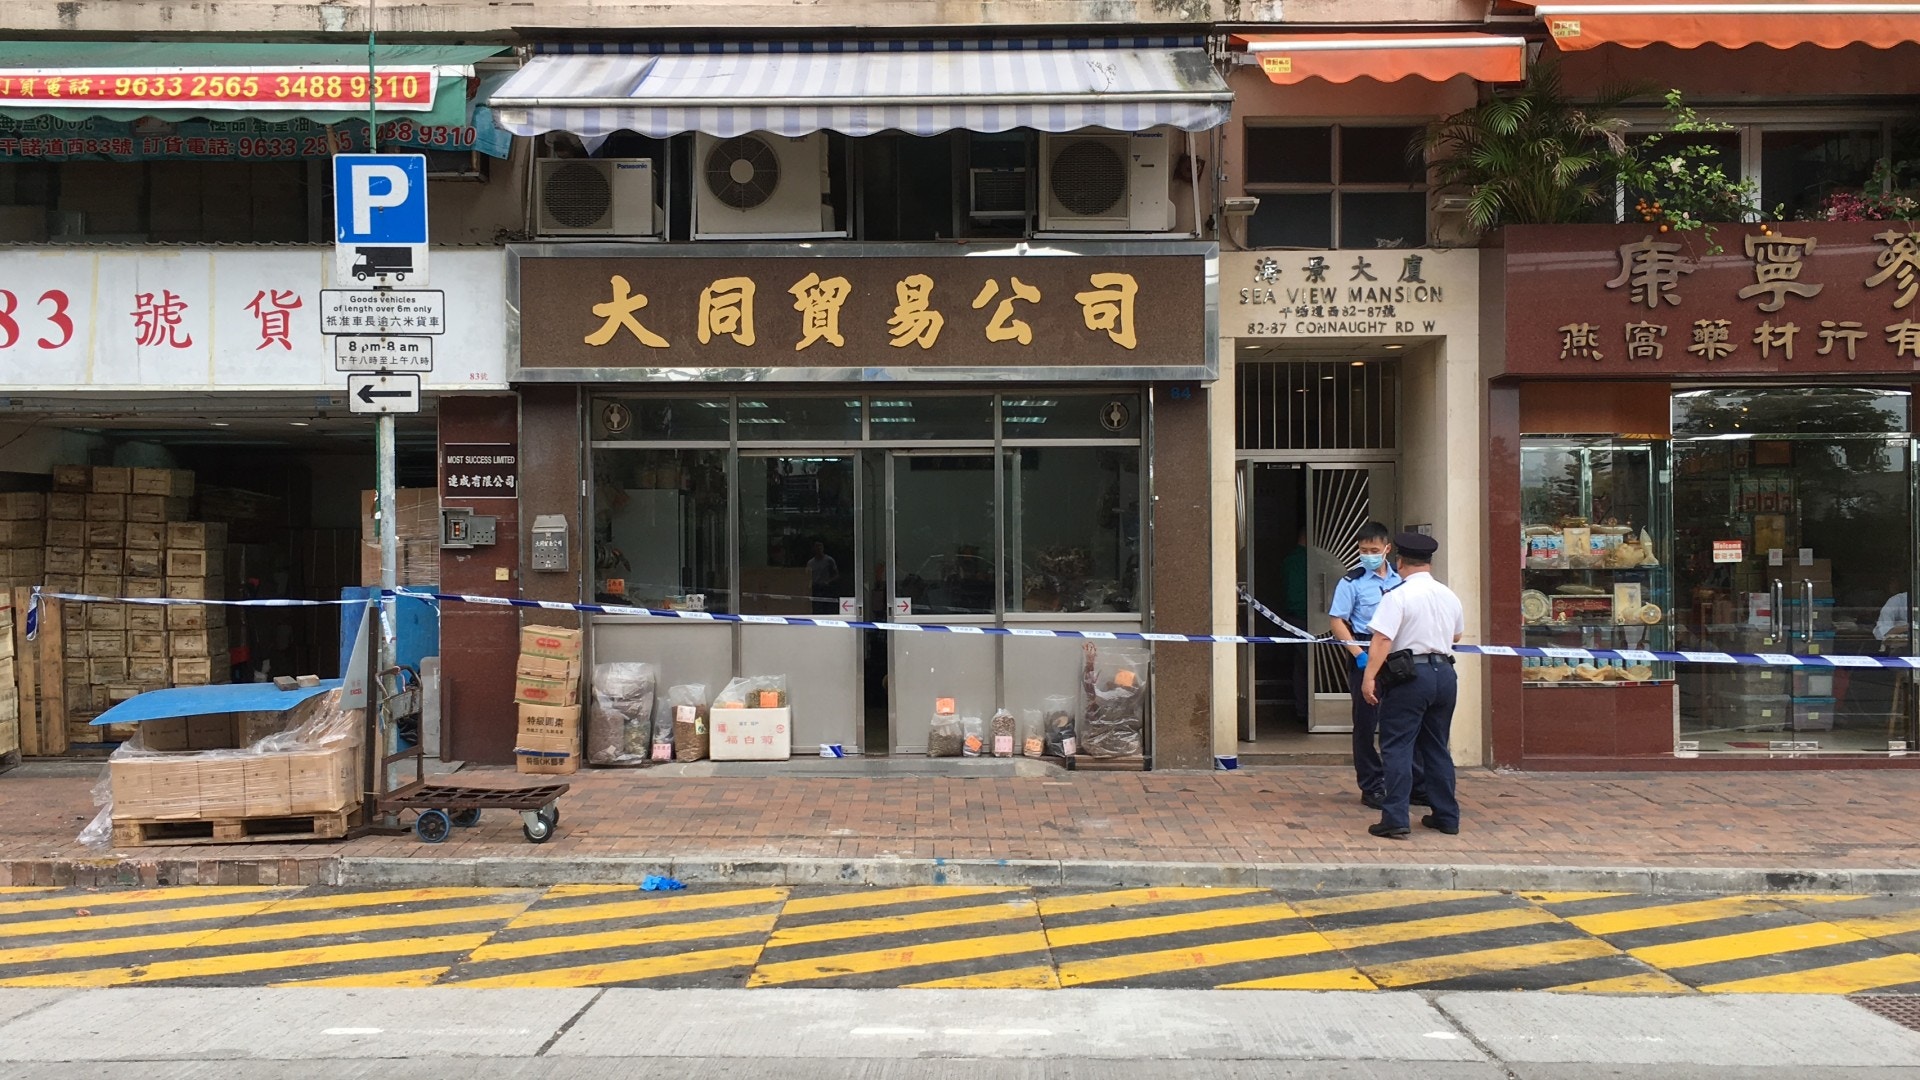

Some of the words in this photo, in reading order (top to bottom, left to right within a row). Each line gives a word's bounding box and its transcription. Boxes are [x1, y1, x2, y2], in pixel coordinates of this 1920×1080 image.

[115, 77, 182, 96] 9633
[191, 76, 259, 97] 2565
[275, 76, 342, 98] 3488
[350, 75, 418, 98] 9310
[0, 137, 133, 156] 干諾道西83號
[143, 136, 235, 155] 訂貨電話:
[239, 136, 297, 157] 9633
[302, 130, 353, 156] 255
[418, 125, 477, 146] 9310
[352, 164, 409, 235] P
[1254, 254, 1426, 285] 海景大廈
[350, 295, 378, 304] Goods
[380, 296, 416, 304] vehicles
[1240, 286, 1279, 305] SEA
[1287, 286, 1337, 304] VIEW
[1349, 285, 1443, 303] MANSION
[333, 305, 342, 313] of
[344, 305, 373, 314] length
[397, 305, 411, 313] 6m
[413, 306, 432, 314] only
[584, 272, 1139, 351] 大同貿易公司
[1247, 323, 1287, 334] 82-87
[1295, 320, 1387, 334] CONNAUGHT
[1395, 320, 1414, 333] RD
[1423, 320, 1436, 332] W
[348, 341, 357, 351] 8
[399, 343, 419, 352] am
[1557, 318, 1920, 361] 燕窩藥材行有
[338, 356, 430, 365] 下午八時至上午八時
[469, 372, 489, 381] 83號
[1170, 386, 1193, 400] 84
[447, 455, 464, 464] MOST
[465, 455, 492, 464] SUCCESS
[493, 455, 515, 464] LIMITED
